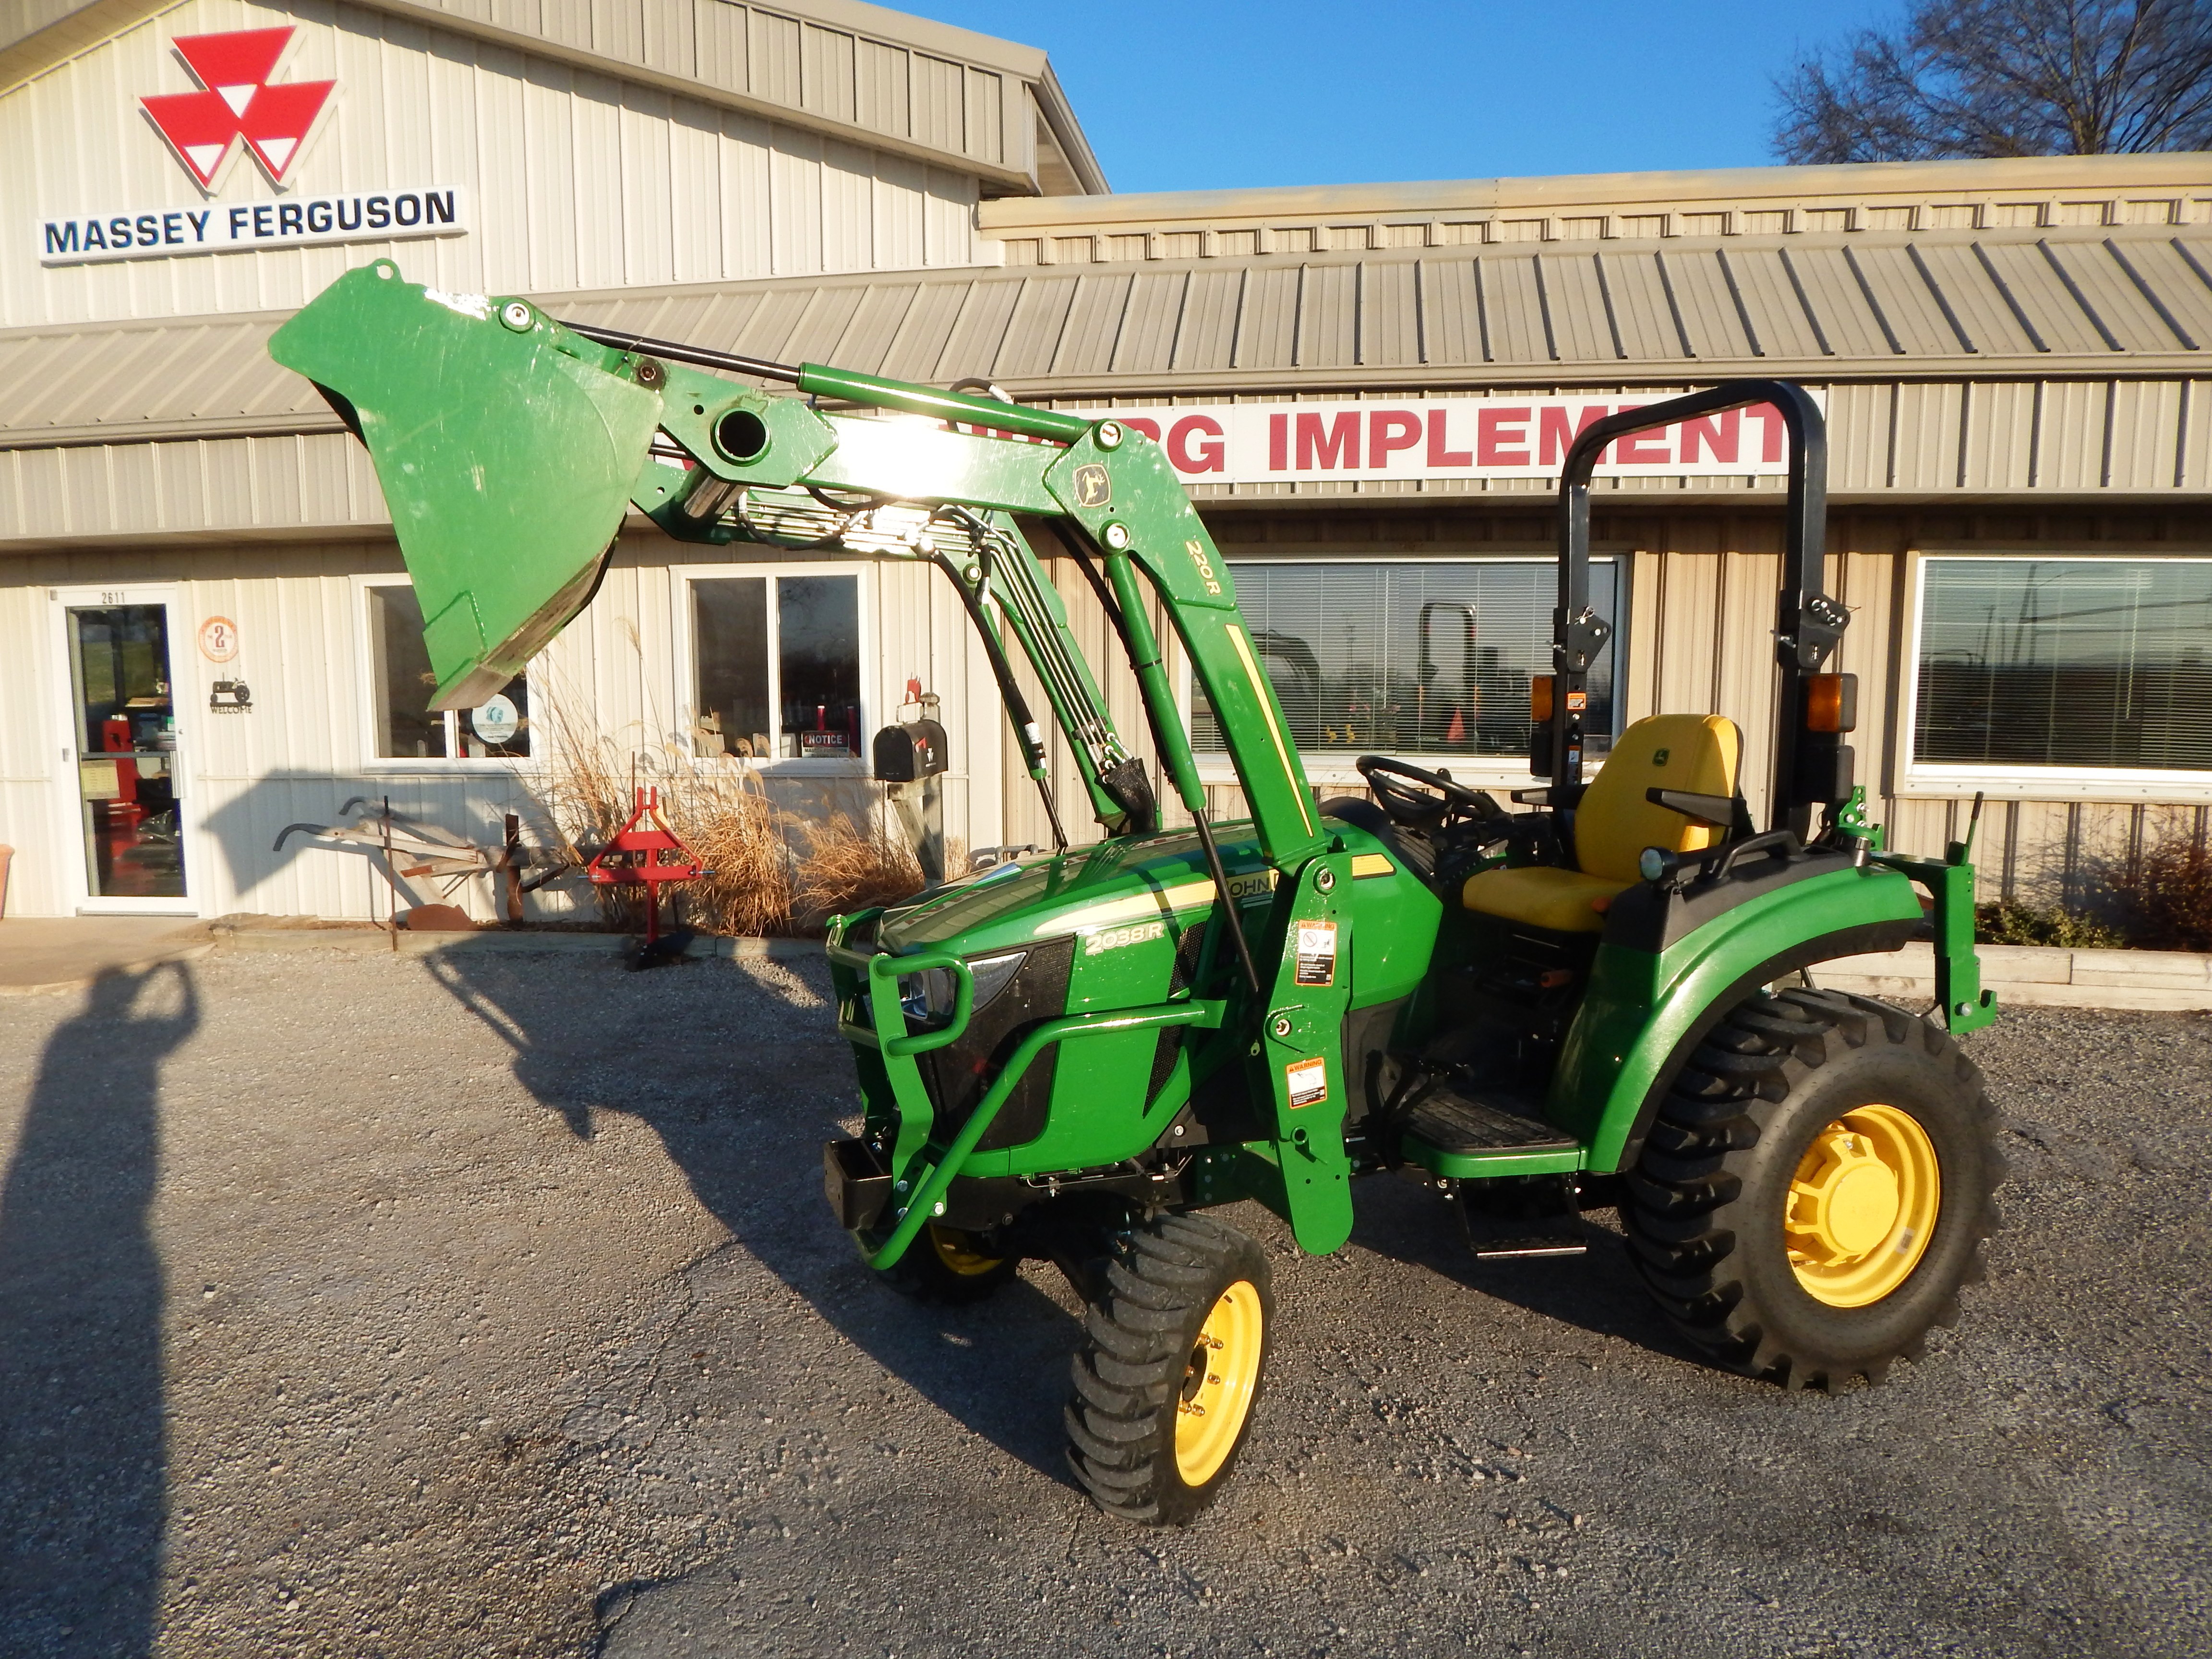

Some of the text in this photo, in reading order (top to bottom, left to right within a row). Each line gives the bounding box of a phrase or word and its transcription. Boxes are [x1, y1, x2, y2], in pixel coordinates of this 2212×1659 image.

[45, 190, 455, 254] MASSEY FERGUSON
[1270, 401, 1786, 470] IMPLEMENT
[1185, 540, 1222, 596] 220R
[102, 592, 125, 604] 2611
[214, 625, 225, 648] 2
[210, 706, 252, 714] WELCOME
[809, 735, 842, 744] NOTICE
[1227, 877, 1270, 896] OHN
[1294, 1059, 1322, 1071] WARNING
